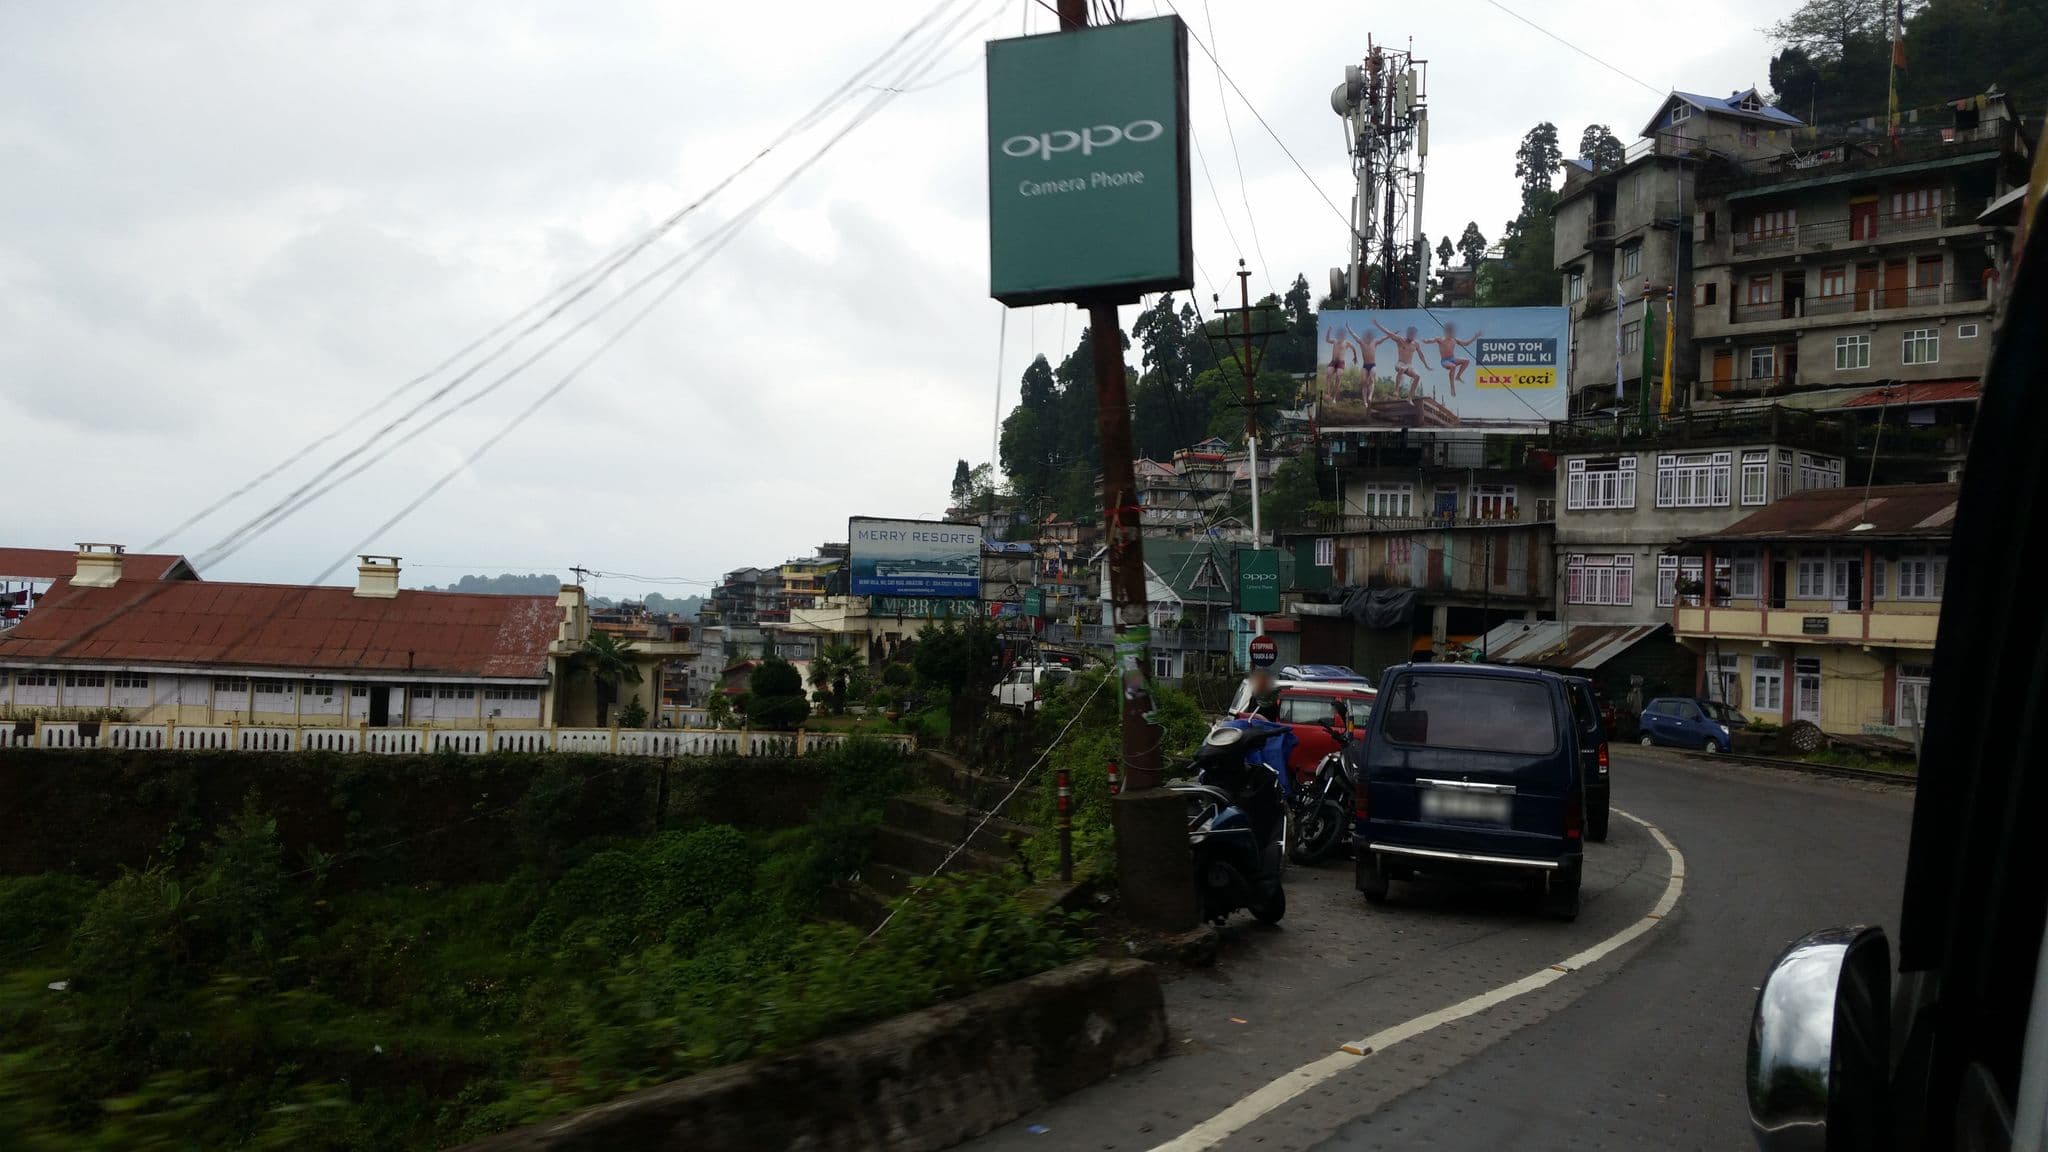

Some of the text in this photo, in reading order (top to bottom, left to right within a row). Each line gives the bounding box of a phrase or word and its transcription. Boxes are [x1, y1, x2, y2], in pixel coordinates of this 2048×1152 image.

[1019, 170, 1144, 197] Camera Phone
[1482, 342, 1542, 351] SUNO TOH
[1482, 353, 1552, 362] APNE DIL KI
[1518, 372, 1551, 385] cozi
[858, 530, 975, 543] MERRY RESORTS
